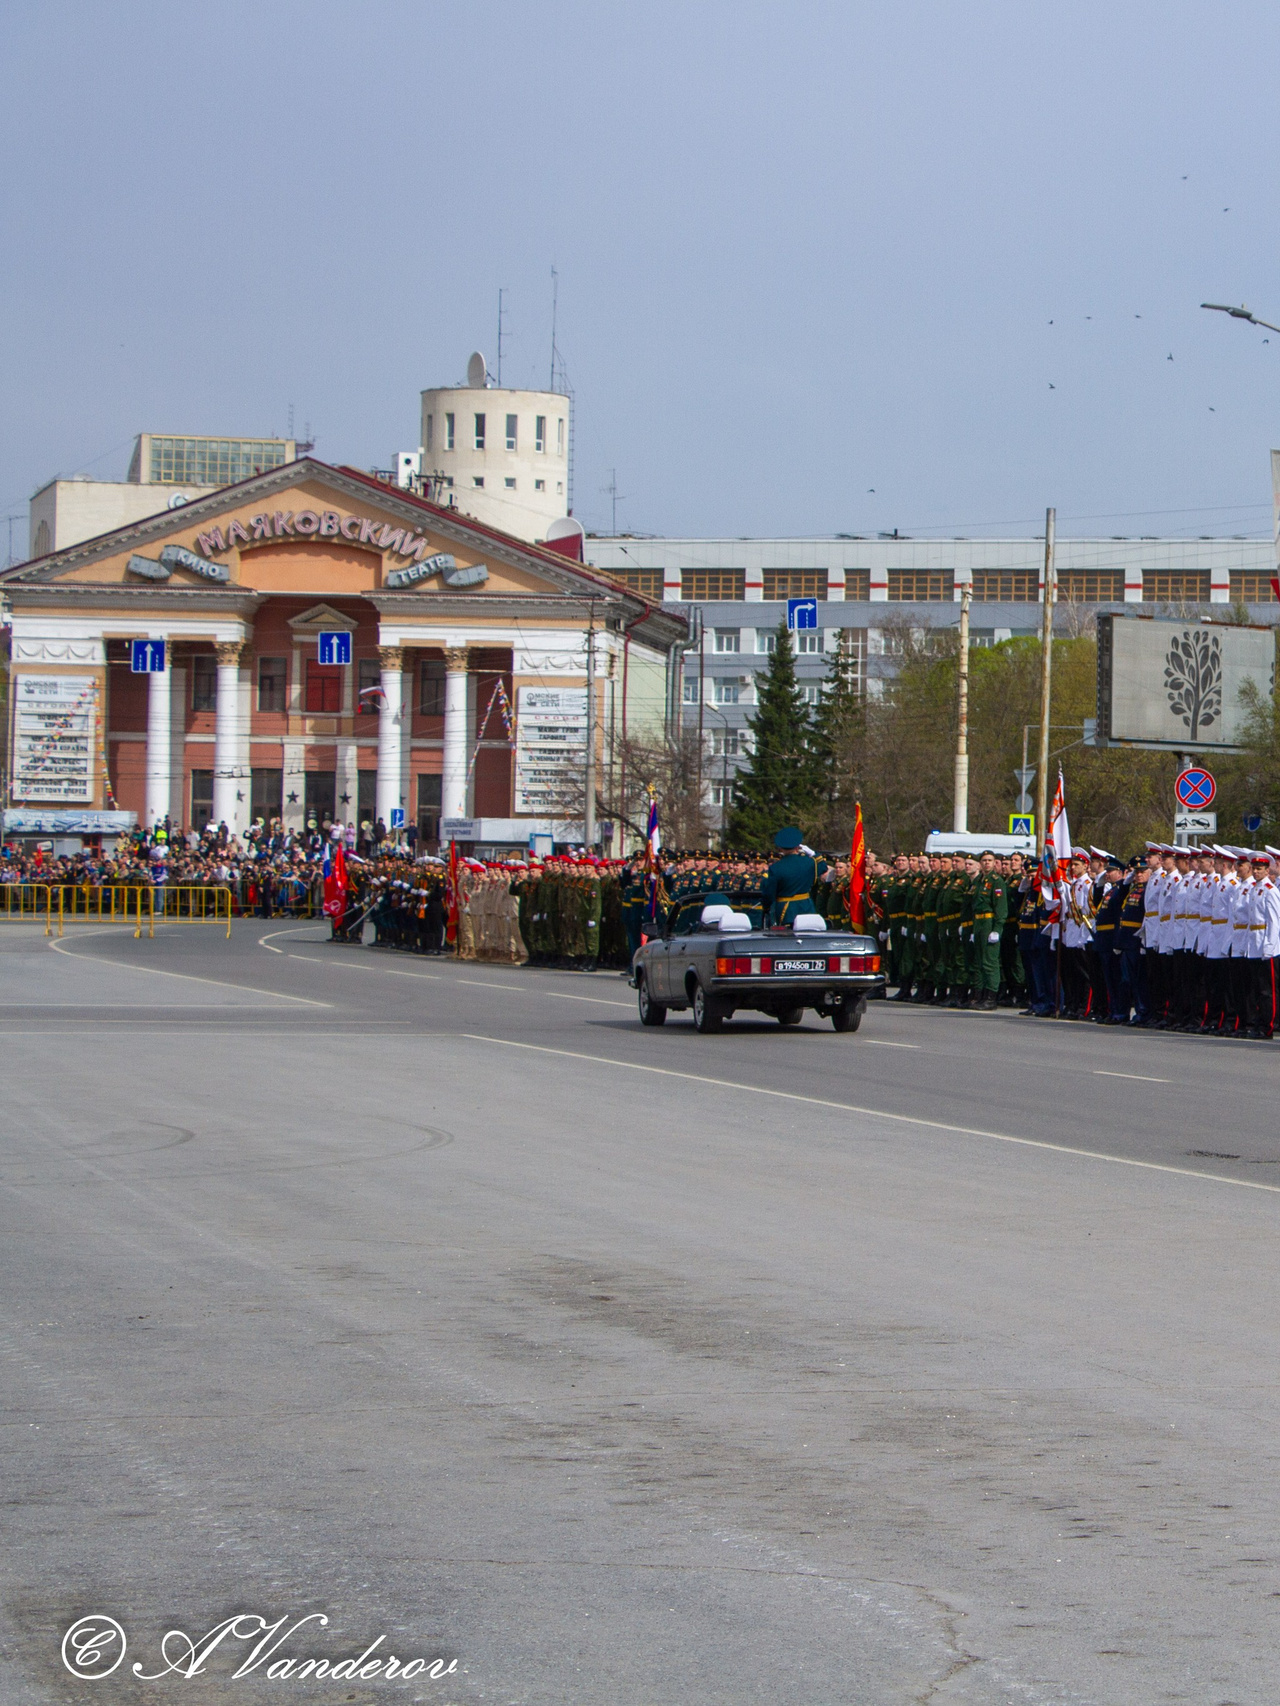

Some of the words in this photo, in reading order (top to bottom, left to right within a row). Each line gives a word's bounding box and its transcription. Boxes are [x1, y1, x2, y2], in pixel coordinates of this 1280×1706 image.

[196, 510, 430, 560] МАЯКОВСКИЙ
[177, 549, 220, 576] КИНО
[398, 556, 446, 583] ТЕАТР
